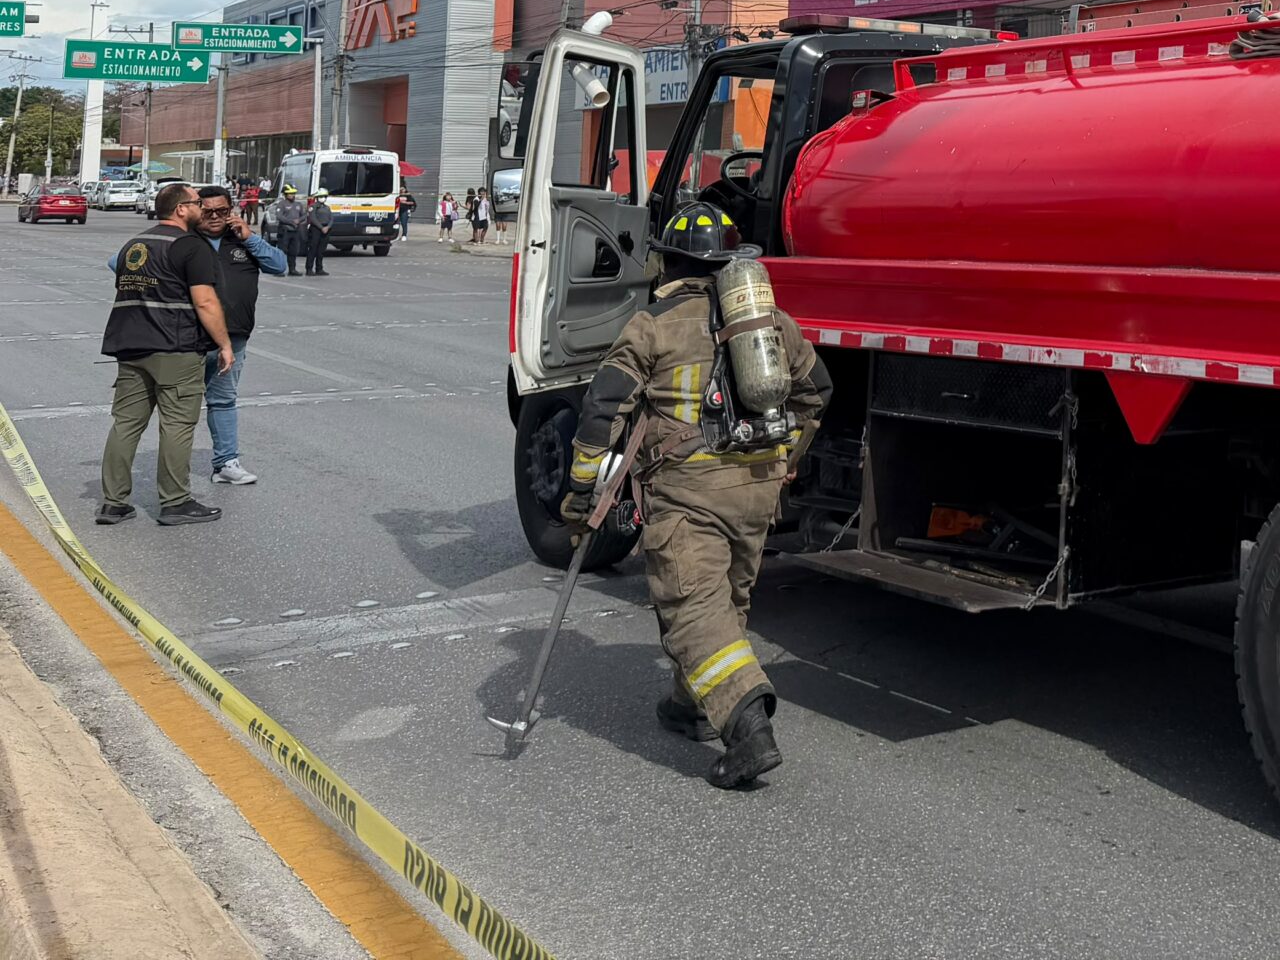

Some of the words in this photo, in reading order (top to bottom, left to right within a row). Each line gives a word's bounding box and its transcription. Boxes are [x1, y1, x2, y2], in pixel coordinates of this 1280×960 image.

[212, 27, 270, 38] ENTRADA
[204, 39, 277, 49] ESTACIONAMIENTO
[104, 48, 181, 61] ENTRADA
[102, 64, 181, 77] ESTACIONAMIENTO
